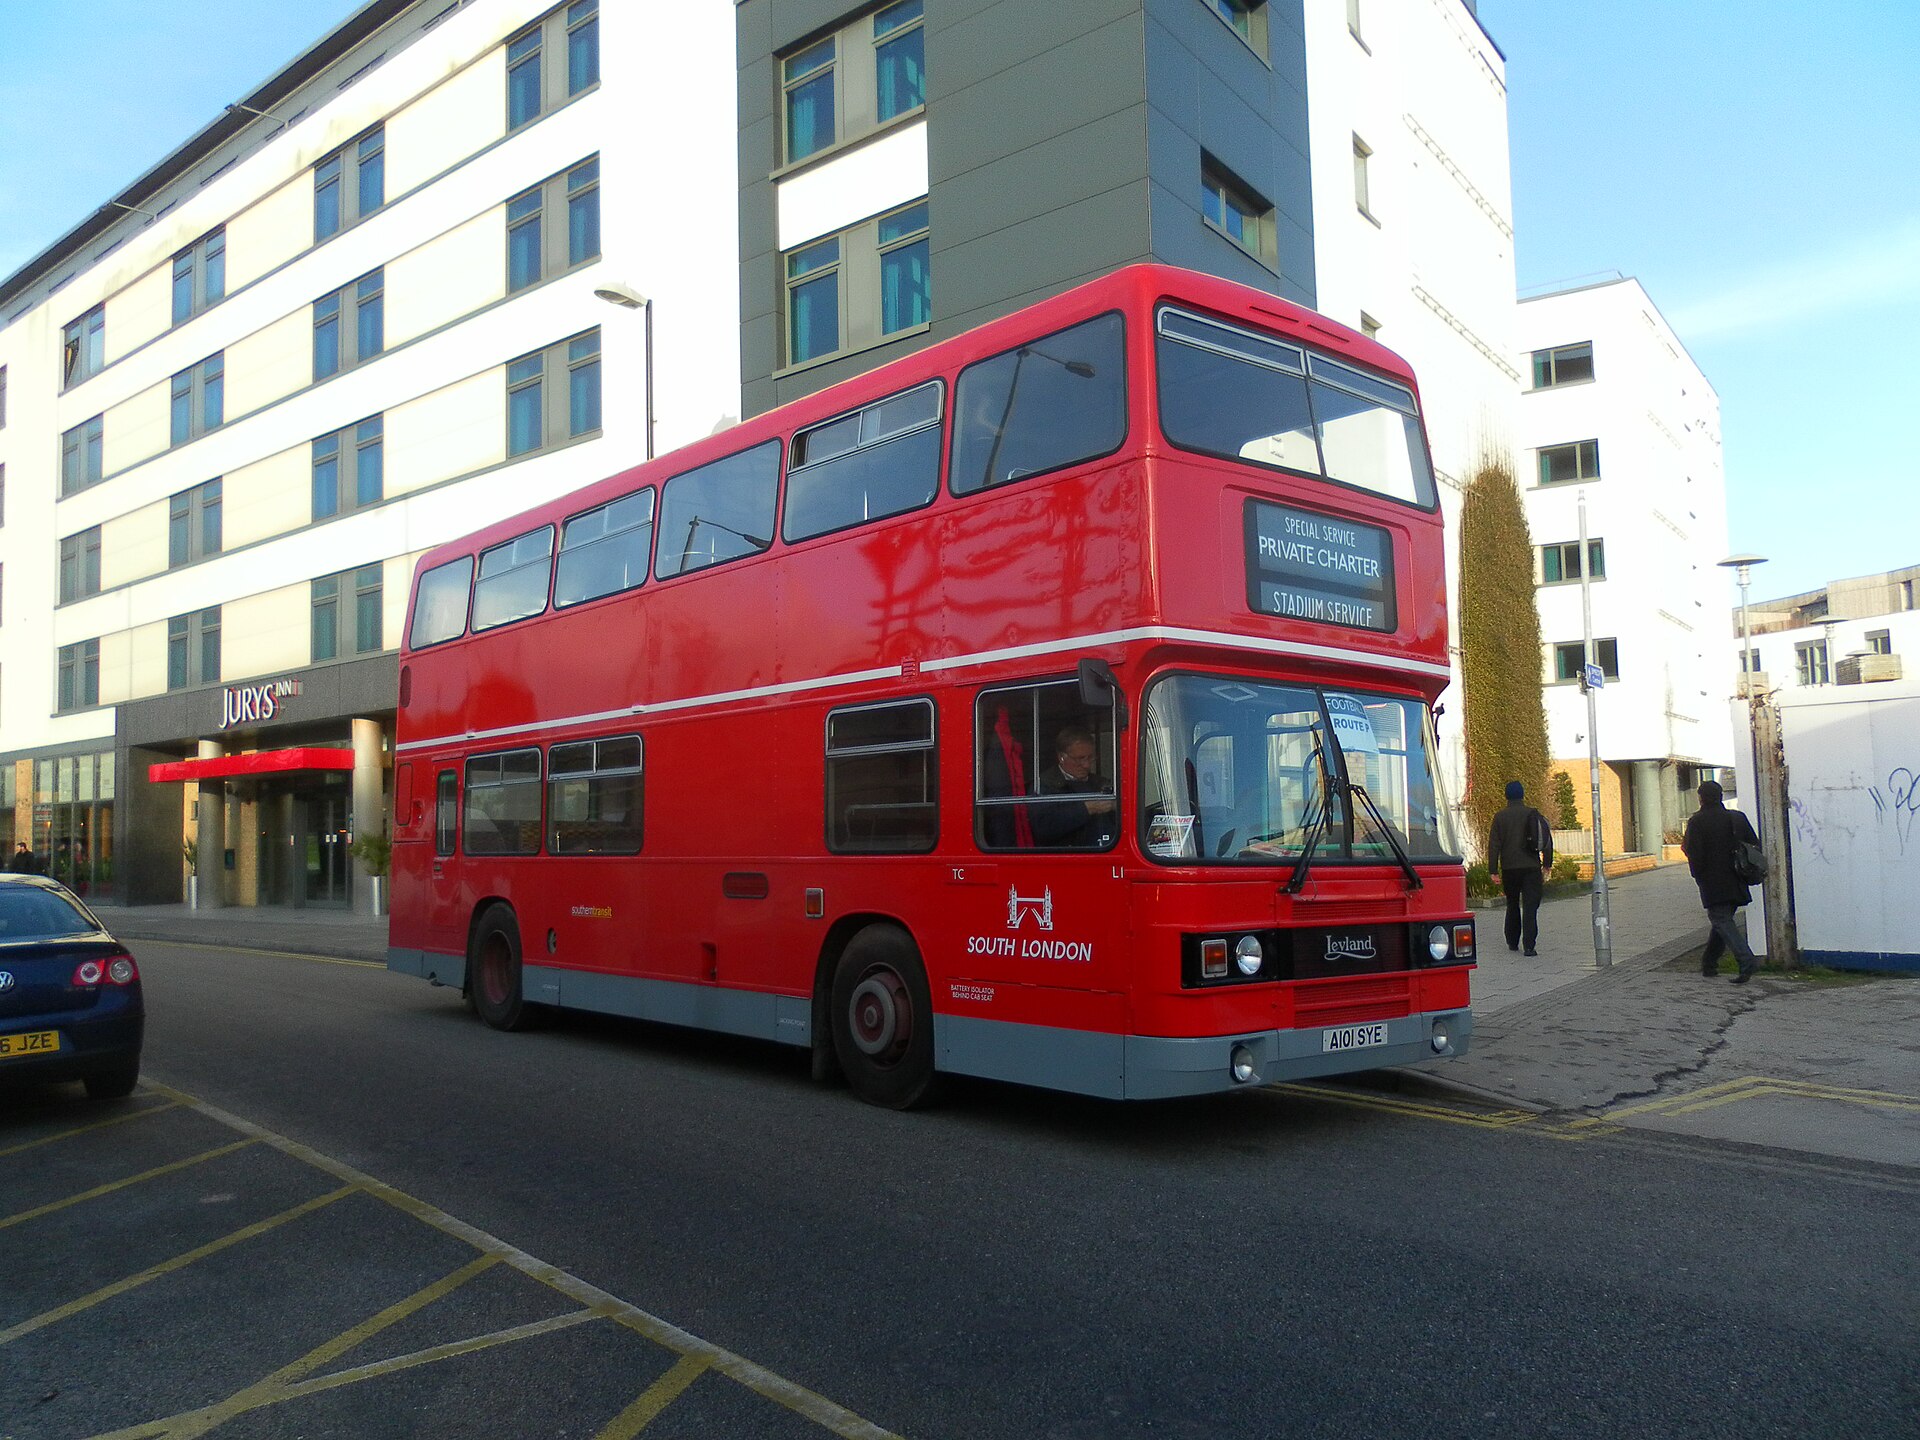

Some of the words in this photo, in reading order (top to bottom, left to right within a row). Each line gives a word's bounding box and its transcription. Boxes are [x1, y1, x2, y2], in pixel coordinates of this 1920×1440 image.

[1284, 516, 1320, 540] SPECIAL
[1322, 525, 1356, 548] SERVICE
[1258, 535, 1315, 565] PRIVATE
[1317, 549, 1380, 578] CHARTER
[1273, 591, 1324, 620] STADIUM
[1327, 601, 1373, 627] SERVICE
[218, 683, 274, 729] JURYS
[275, 680, 292, 697] INN
[1333, 718, 1364, 732] ROUTE
[1364, 723, 1370, 733] P
[952, 868, 965, 880] TC
[967, 936, 1016, 956] SOUTH
[1021, 939, 1092, 962] LONDON
[1324, 935, 1377, 961] Leyland
[950, 984, 971, 992] BATTERY
[970, 986, 995, 995] ISOLATOR
[952, 991, 970, 999] BEHIND
[17, 1032, 53, 1051] JZE
[1357, 1025, 1382, 1046] SYE
